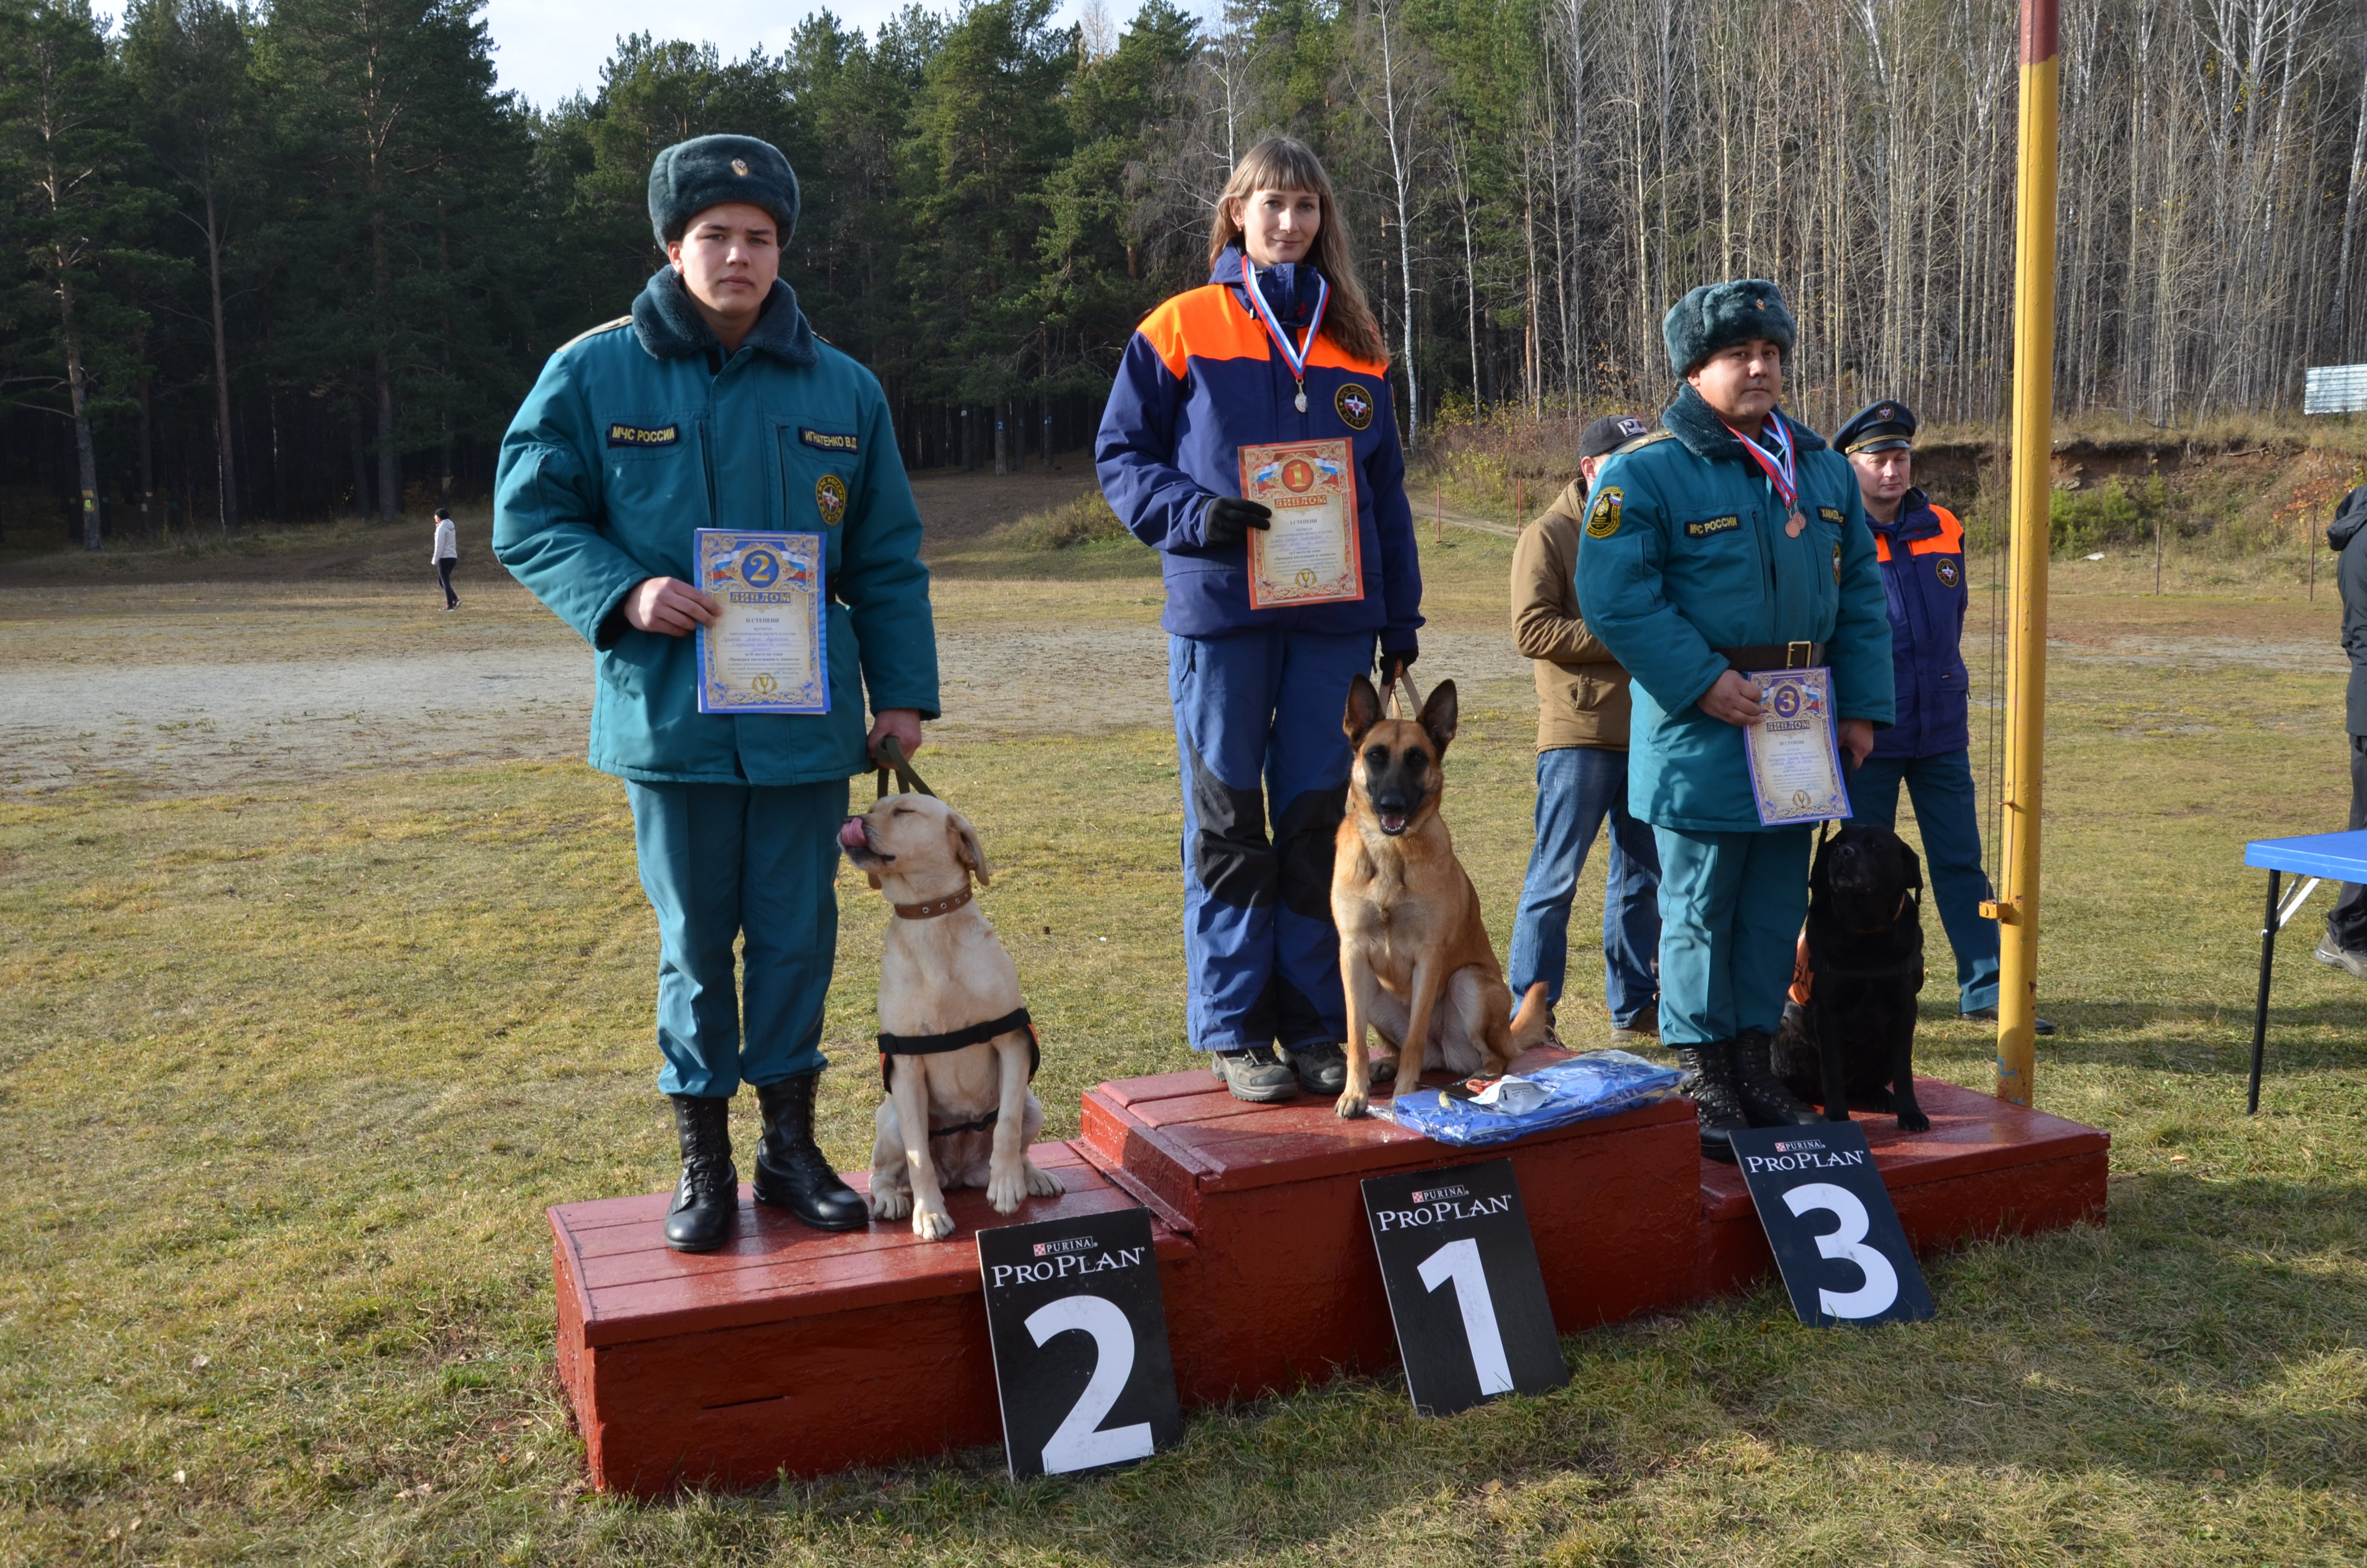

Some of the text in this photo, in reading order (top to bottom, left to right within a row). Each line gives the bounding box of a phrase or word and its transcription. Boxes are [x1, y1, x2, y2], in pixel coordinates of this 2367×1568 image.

[612, 426, 674, 442] МЧС РОССИИ
[805, 430, 844, 447] ИГНАТЕНКО
[1289, 463, 1307, 487] 1
[818, 478, 844, 500] МЧС РОССИИ
[1275, 495, 1327, 509] ДИПЛОМ
[1704, 517, 1737, 533] РОССИИ
[750, 554, 770, 581] 2
[730, 592, 791, 603] ДИПЛОМ
[1779, 691, 1795, 712] 3
[1766, 720, 1810, 732] ДИПЛОМ
[1785, 1140, 1820, 1151] PURINA
[1423, 1187, 1463, 1201] PURINA
[1046, 1238, 1091, 1253] PURINA
[1782, 1182, 1898, 1319] 3
[1417, 1237, 1514, 1396] 1
[1023, 1294, 1155, 1476] 2
